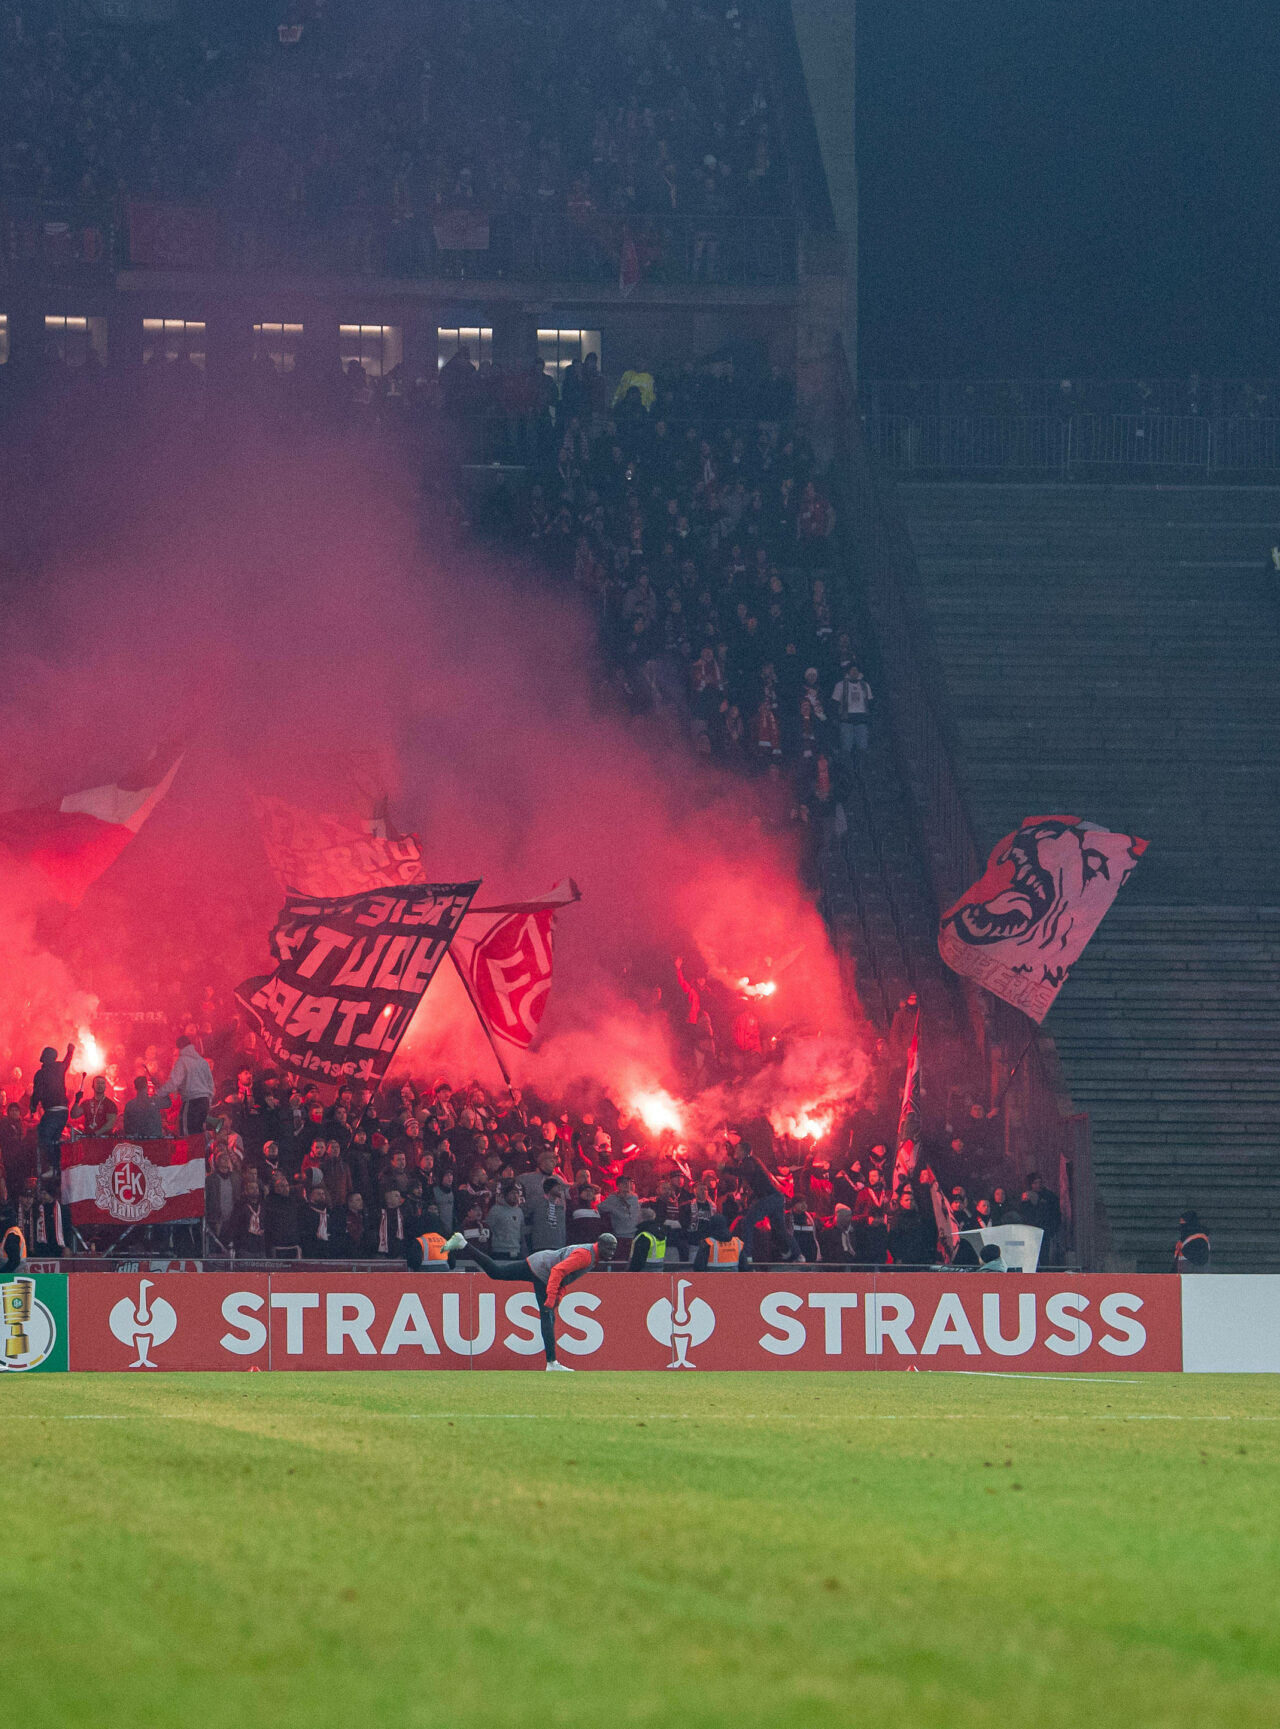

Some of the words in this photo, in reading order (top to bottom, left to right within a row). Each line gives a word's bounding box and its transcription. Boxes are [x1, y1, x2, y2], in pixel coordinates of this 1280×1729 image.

[113, 1200, 150, 1218] Jahre
[220, 1291, 604, 1355] STRAUSS
[758, 1291, 1147, 1356] STRAUSS
